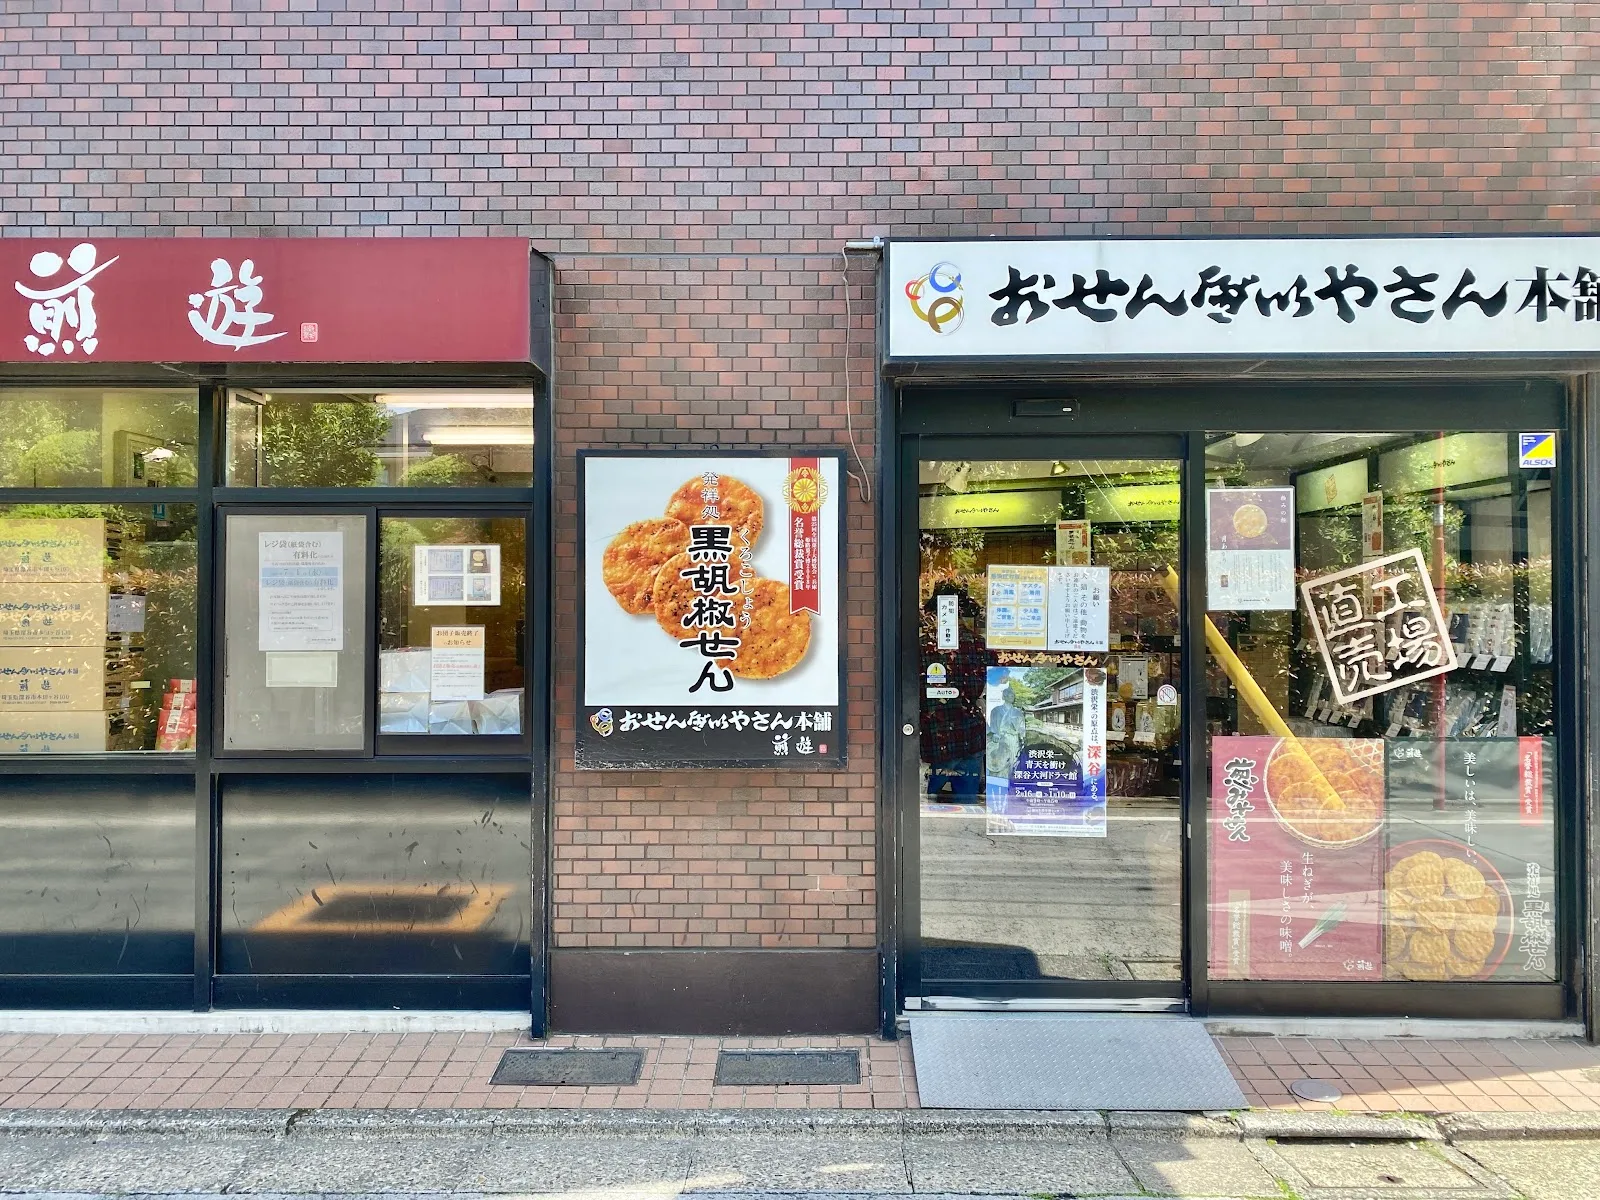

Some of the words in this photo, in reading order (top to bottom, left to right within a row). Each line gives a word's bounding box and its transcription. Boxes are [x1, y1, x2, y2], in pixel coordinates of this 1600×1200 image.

[702, 471, 719, 519] 発祥処
[739, 528, 754, 629] くろこしょう
[793, 516, 804, 591] 名誉総裁賞受賞
[679, 525, 741, 694] 黒胡椒せん
[1320, 583, 1392, 692] 直売
[1372, 573, 1443, 669] 工場
[1014, 771, 1077, 780] 深谷大河ドラマ館
[1025, 760, 1066, 769] 青天を衝け
[1028, 750, 1063, 758] 渋沢栄一
[1087, 745, 1101, 776] 深谷
[1464, 752, 1478, 864] 美しいは、美味しい。
[1279, 860, 1293, 958] 美味しさの味噌。
[1301, 851, 1315, 909] 生ねぎが、
